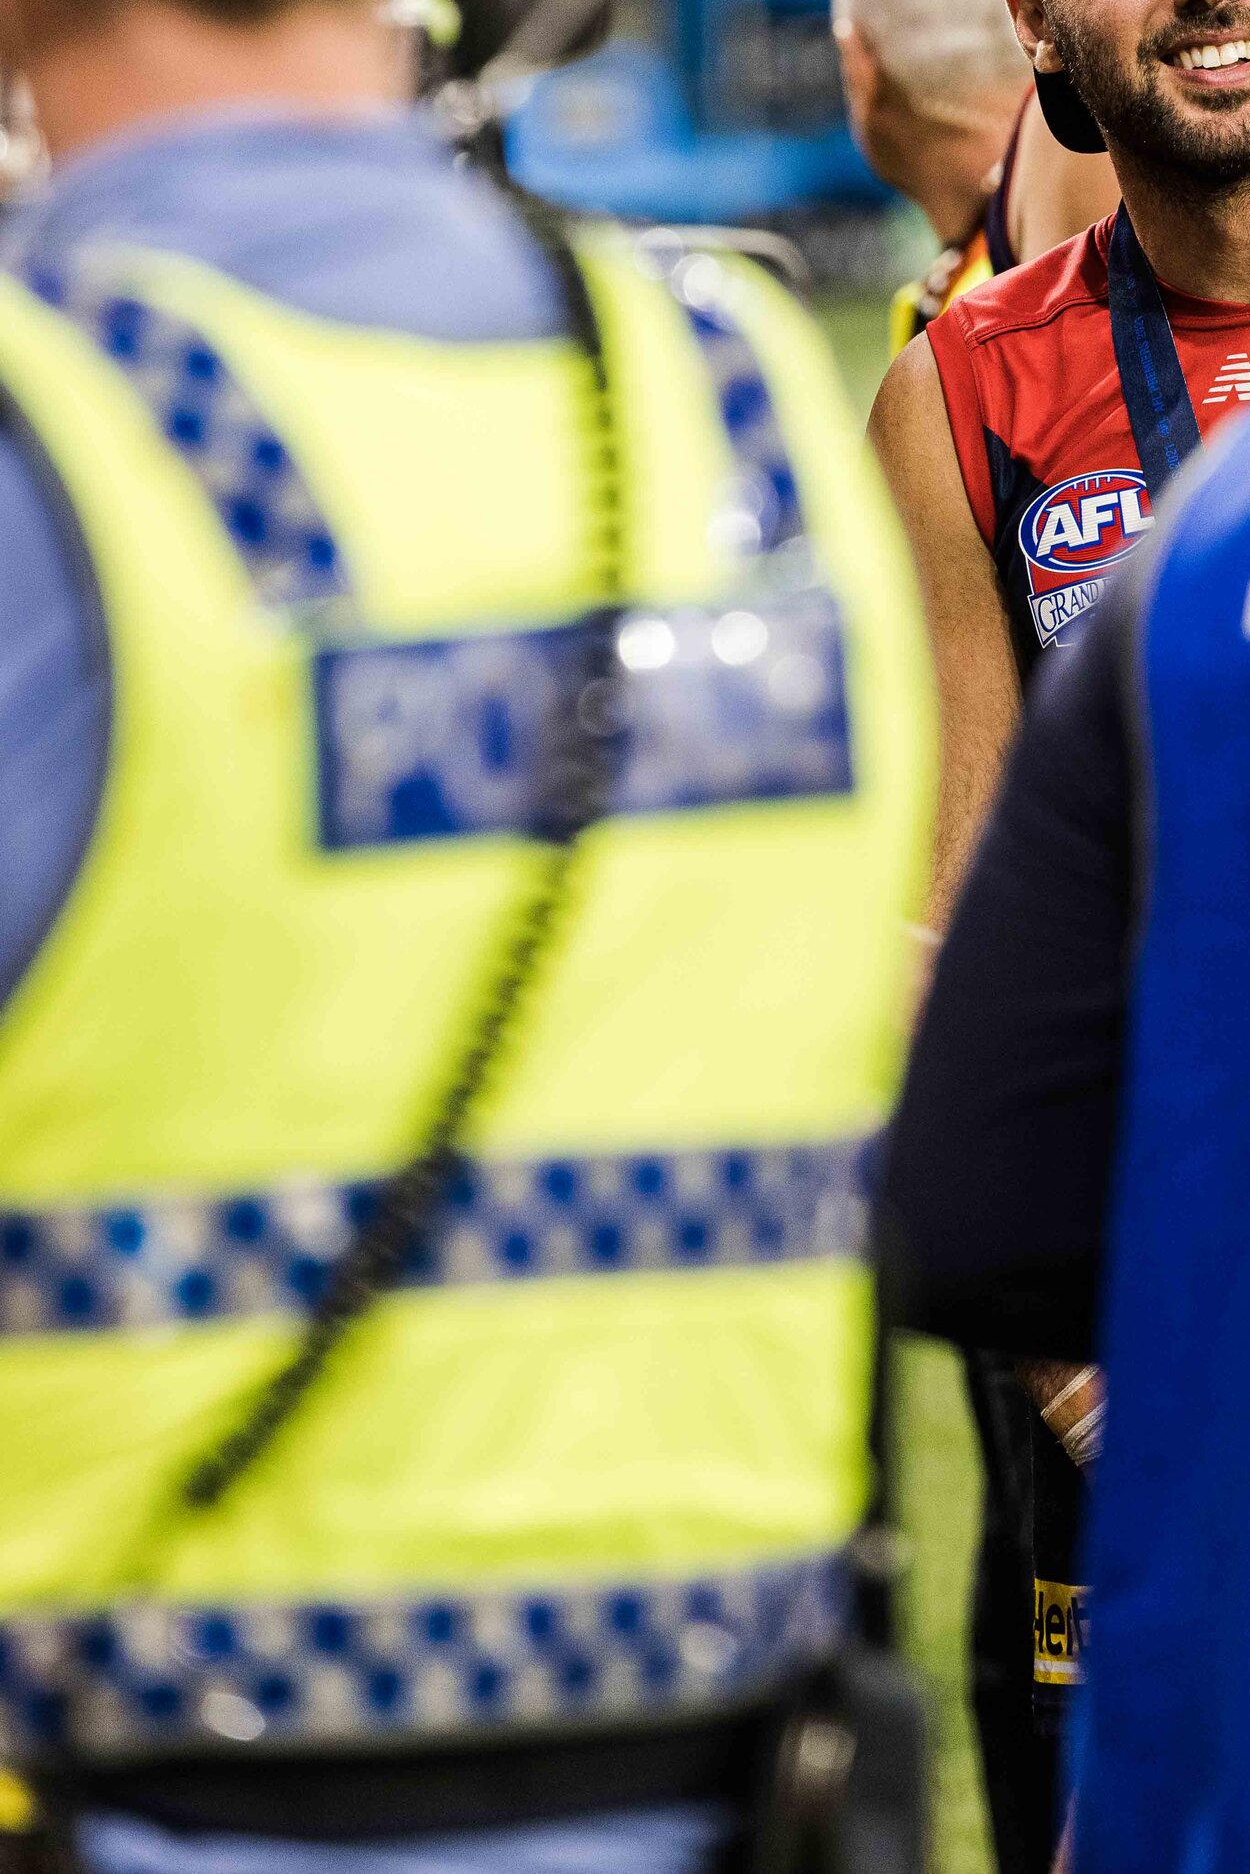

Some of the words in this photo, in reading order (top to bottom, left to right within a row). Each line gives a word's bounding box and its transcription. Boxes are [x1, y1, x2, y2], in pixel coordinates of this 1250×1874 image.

[1139, 340, 1160, 392] PREMIERS
[1036, 486, 1156, 557] AFL
[1037, 580, 1100, 633] GRAND
